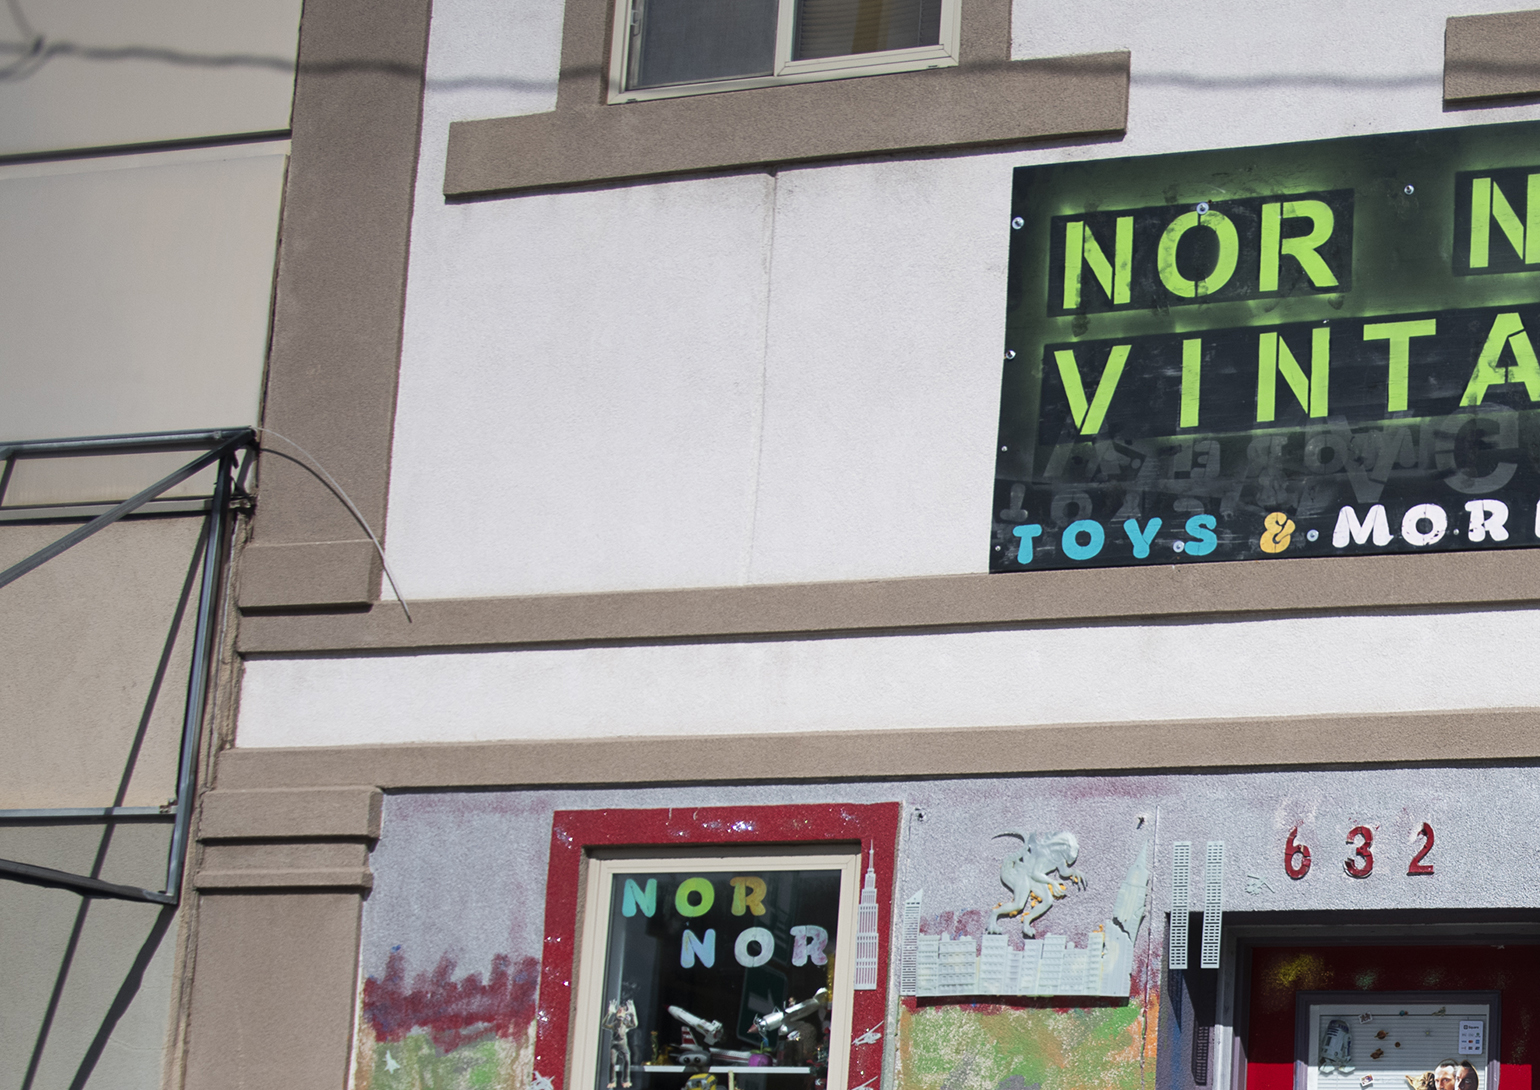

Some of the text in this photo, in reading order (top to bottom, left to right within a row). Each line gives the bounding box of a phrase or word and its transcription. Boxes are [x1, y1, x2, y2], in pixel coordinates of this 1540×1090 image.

[1062, 199, 1340, 310] NOR
[1012, 513, 1218, 565] TOYS
[1259, 511, 1296, 554] &
[1284, 822, 1436, 880] 632
[621, 876, 768, 918] NOR
[681, 924, 829, 969] NOR
